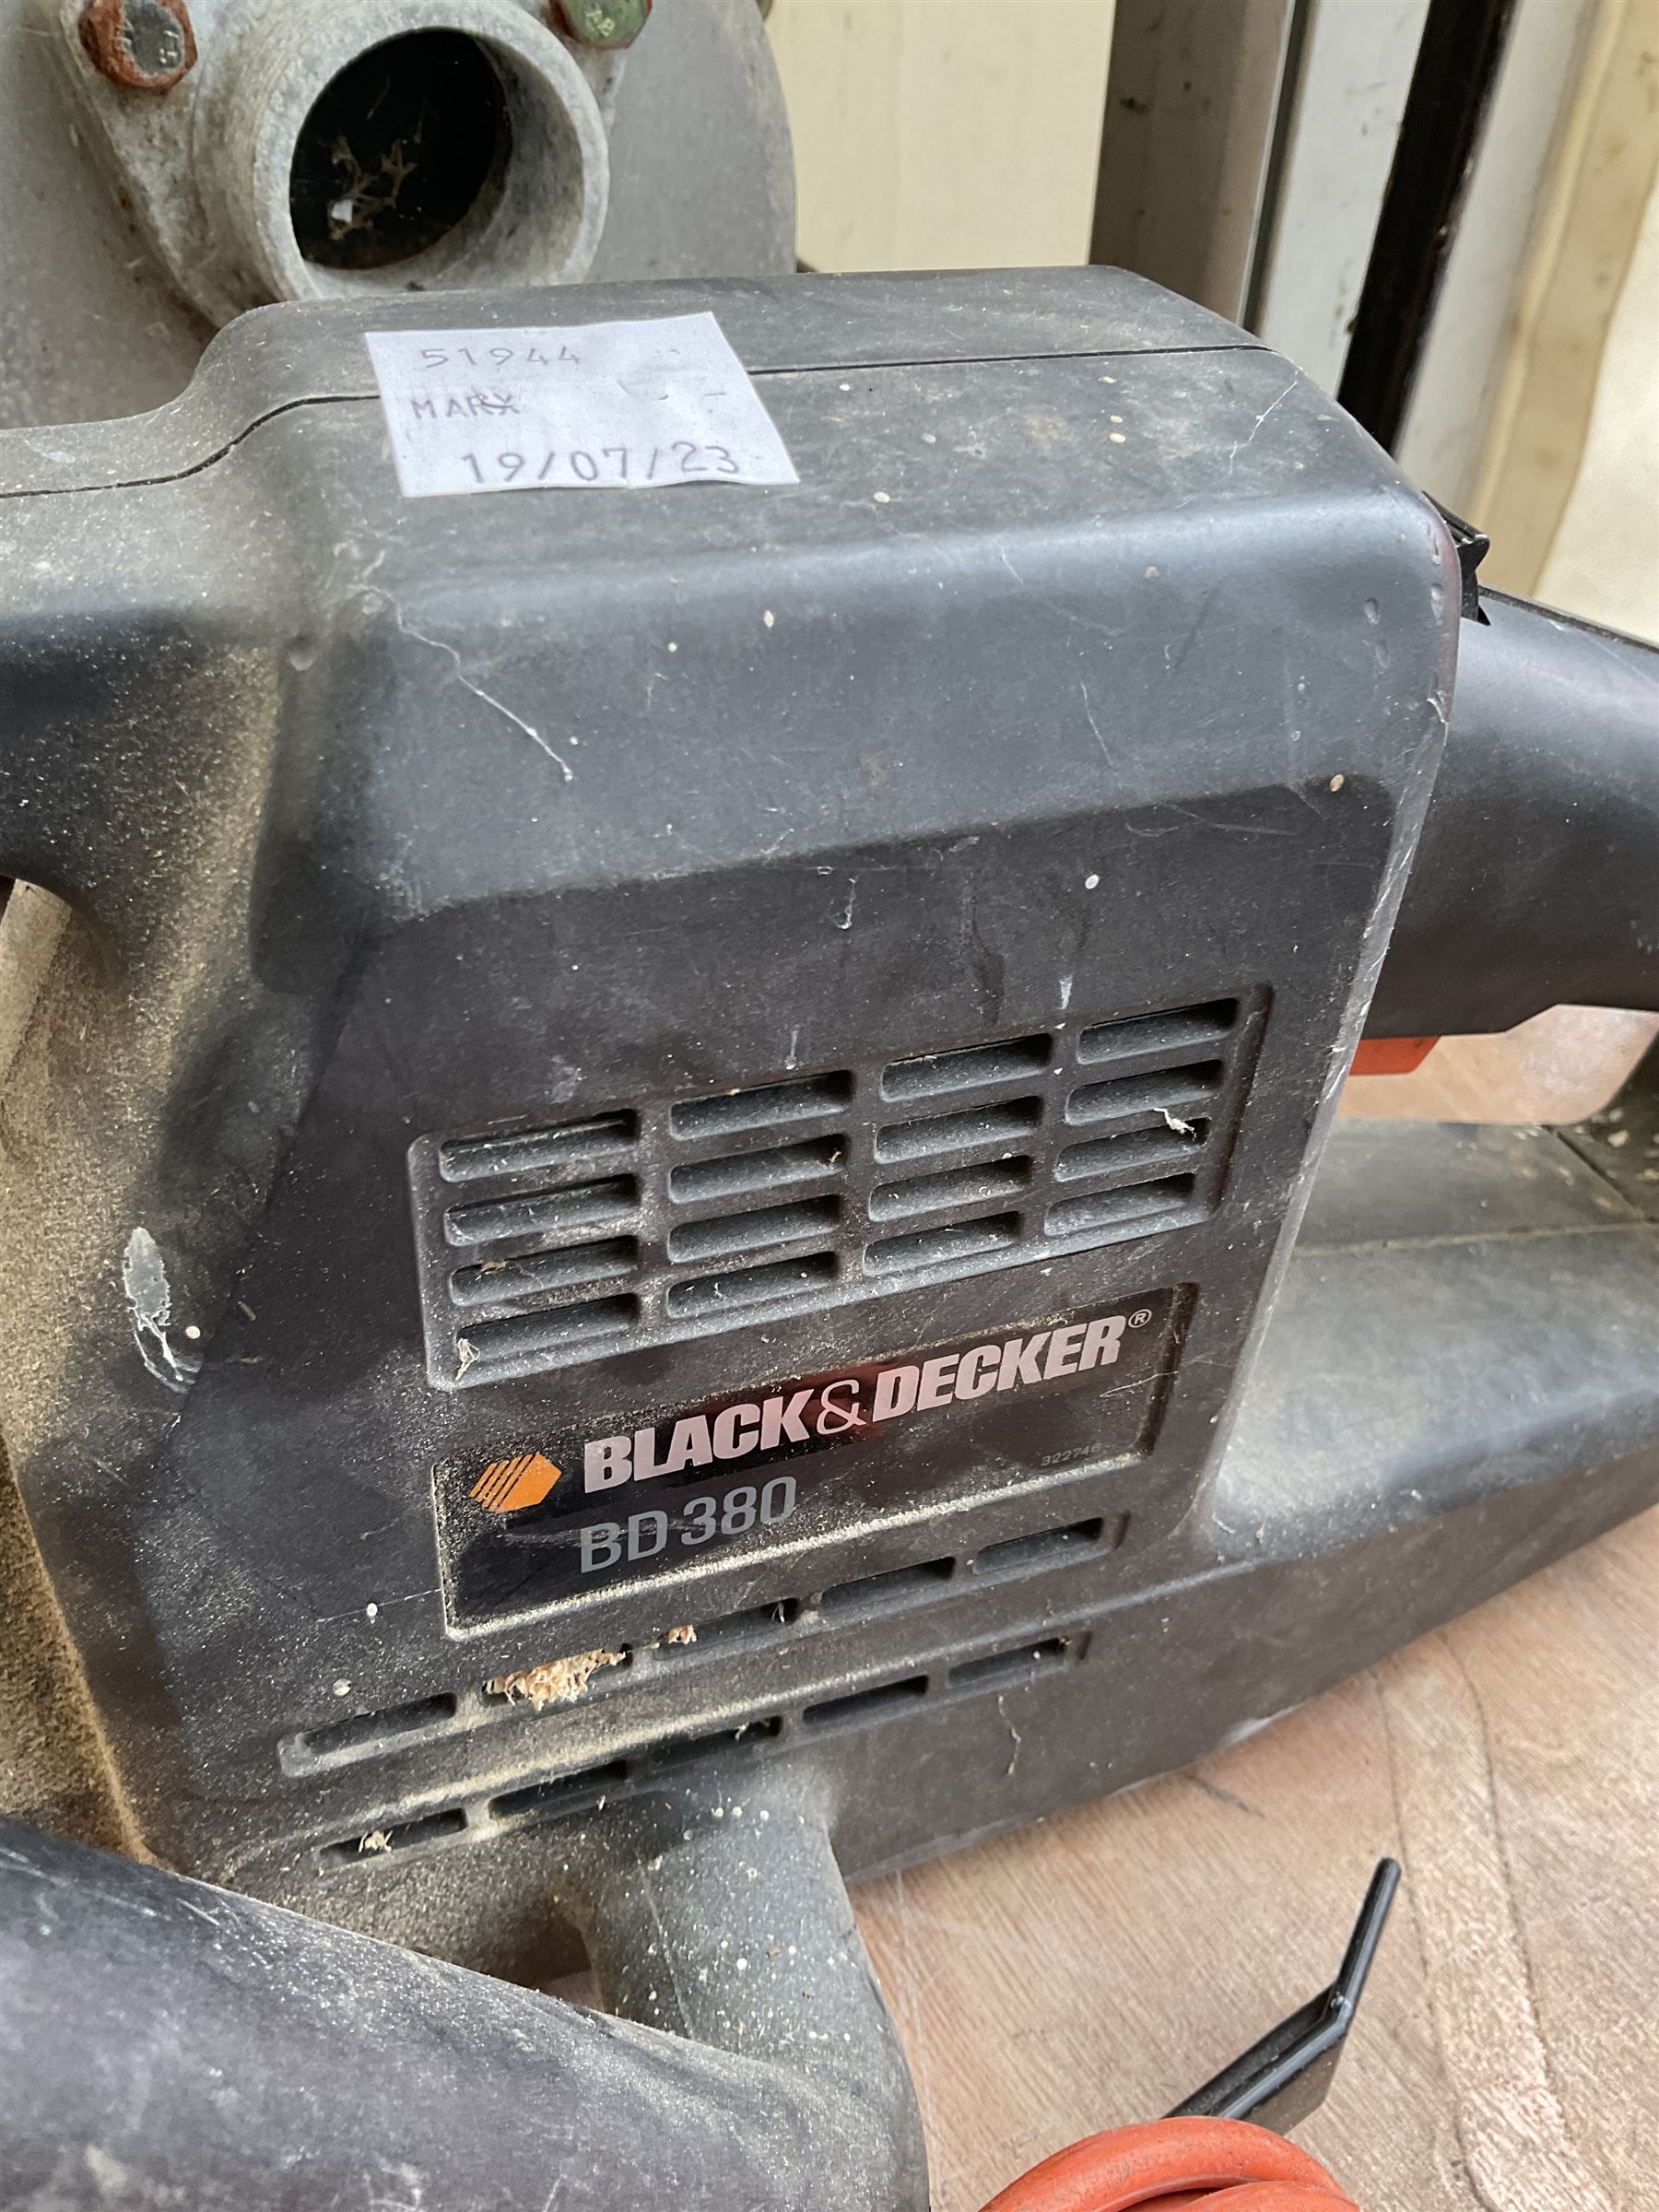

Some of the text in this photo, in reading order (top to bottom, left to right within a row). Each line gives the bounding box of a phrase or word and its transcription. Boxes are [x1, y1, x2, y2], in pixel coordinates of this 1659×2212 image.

[420, 347, 581, 368] 51944
[462, 442, 740, 484] 19/07/23
[580, 1476, 797, 1574] BD 380
